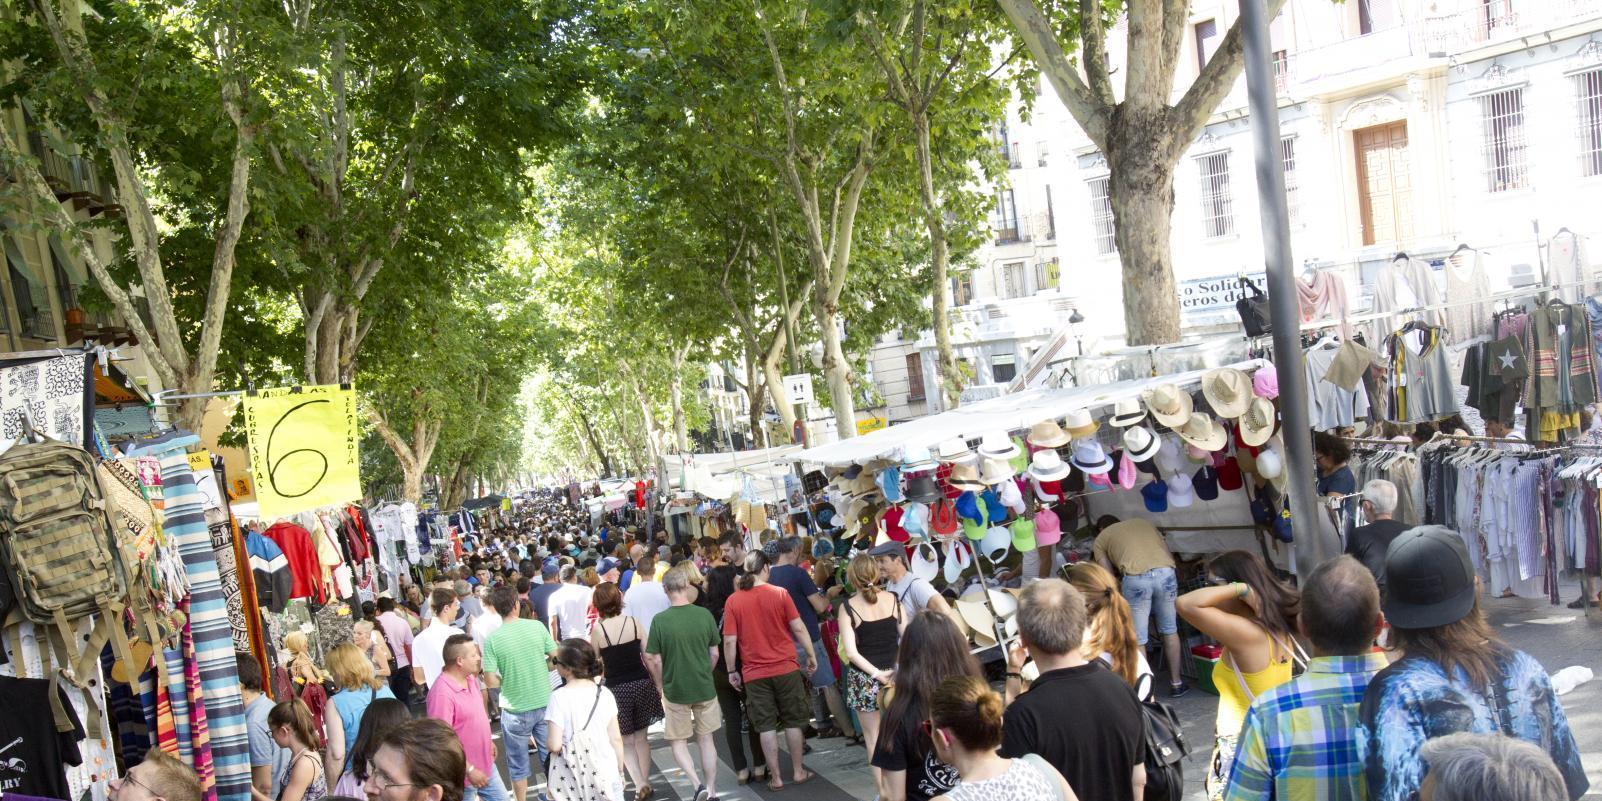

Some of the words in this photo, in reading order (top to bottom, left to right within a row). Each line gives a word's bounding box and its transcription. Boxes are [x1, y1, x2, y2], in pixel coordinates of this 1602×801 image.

[1198, 278, 1265, 294] Solidr
[257, 387, 328, 400] ANDAS
[266, 399, 330, 498] 6
